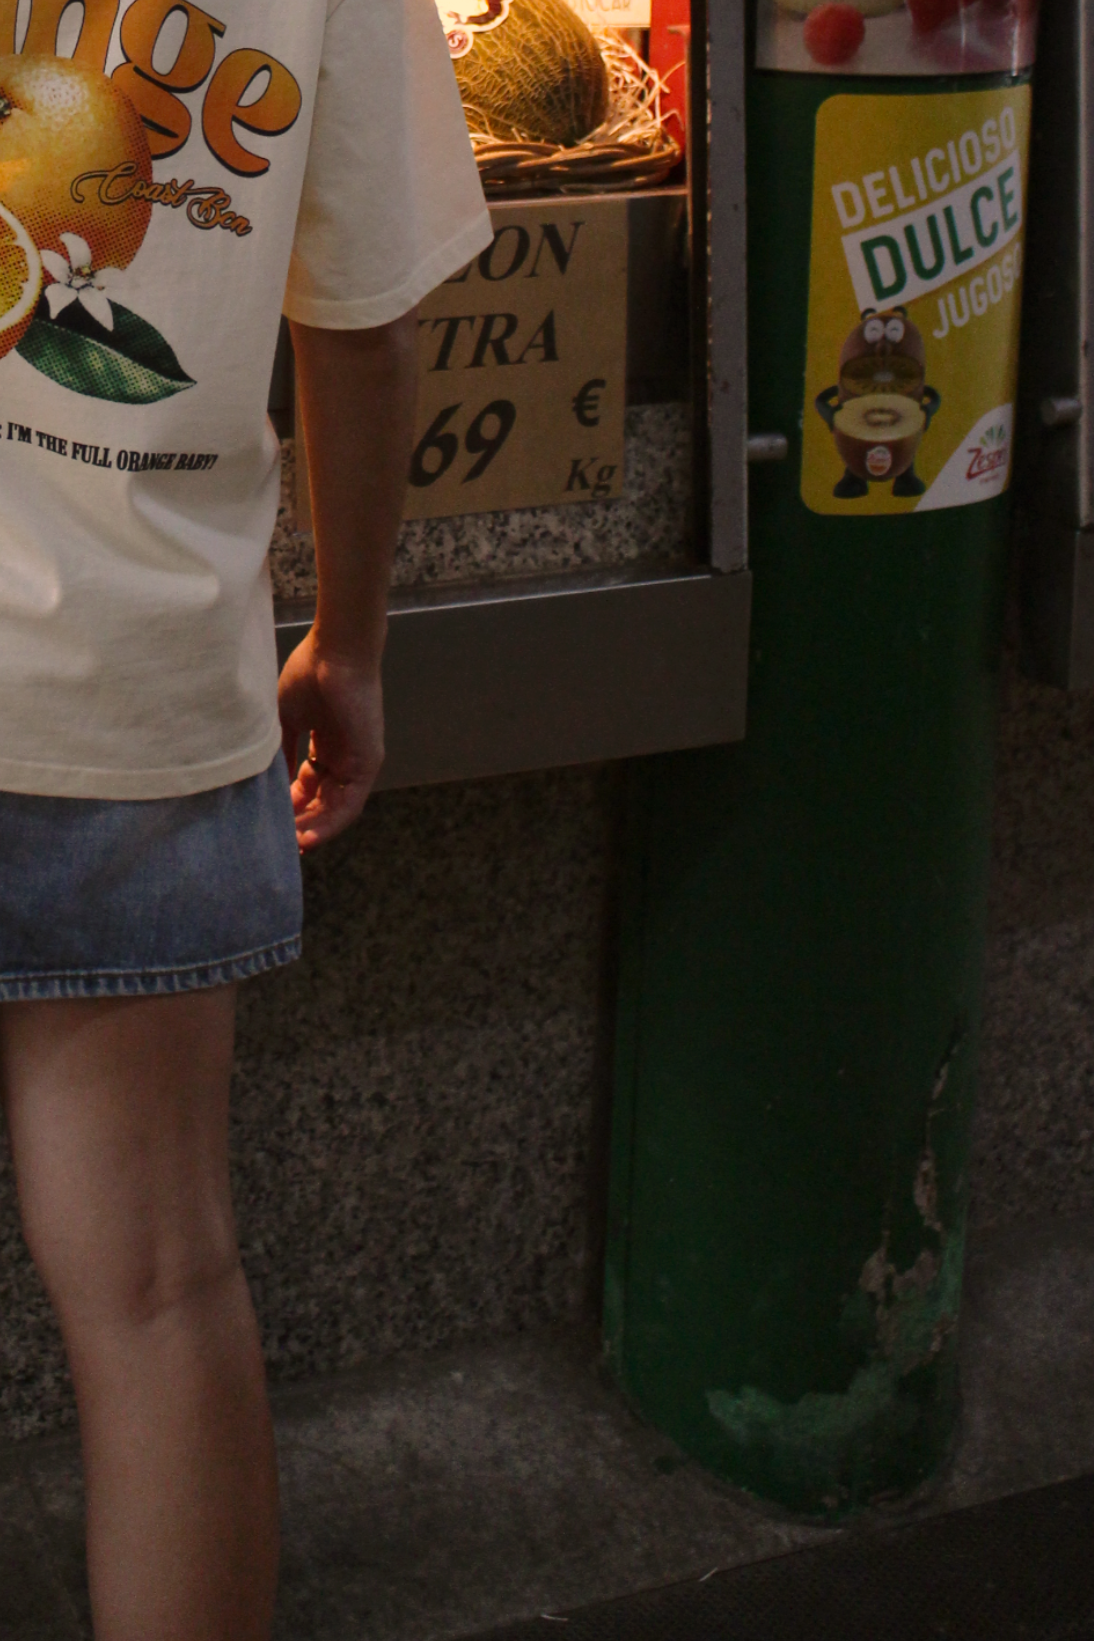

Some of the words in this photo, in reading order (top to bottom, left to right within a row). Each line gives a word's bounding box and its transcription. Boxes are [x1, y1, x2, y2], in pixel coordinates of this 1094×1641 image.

[831, 106, 1016, 228] DELICIOSO
[860, 166, 1019, 301] DULCE
[572, 379, 606, 427] €
[7, 421, 32, 444] I'M
[35, 430, 68, 456] THE
[71, 441, 112, 468] FULL
[116, 449, 178, 472] ORANGE
[563, 457, 617, 496] Kg
